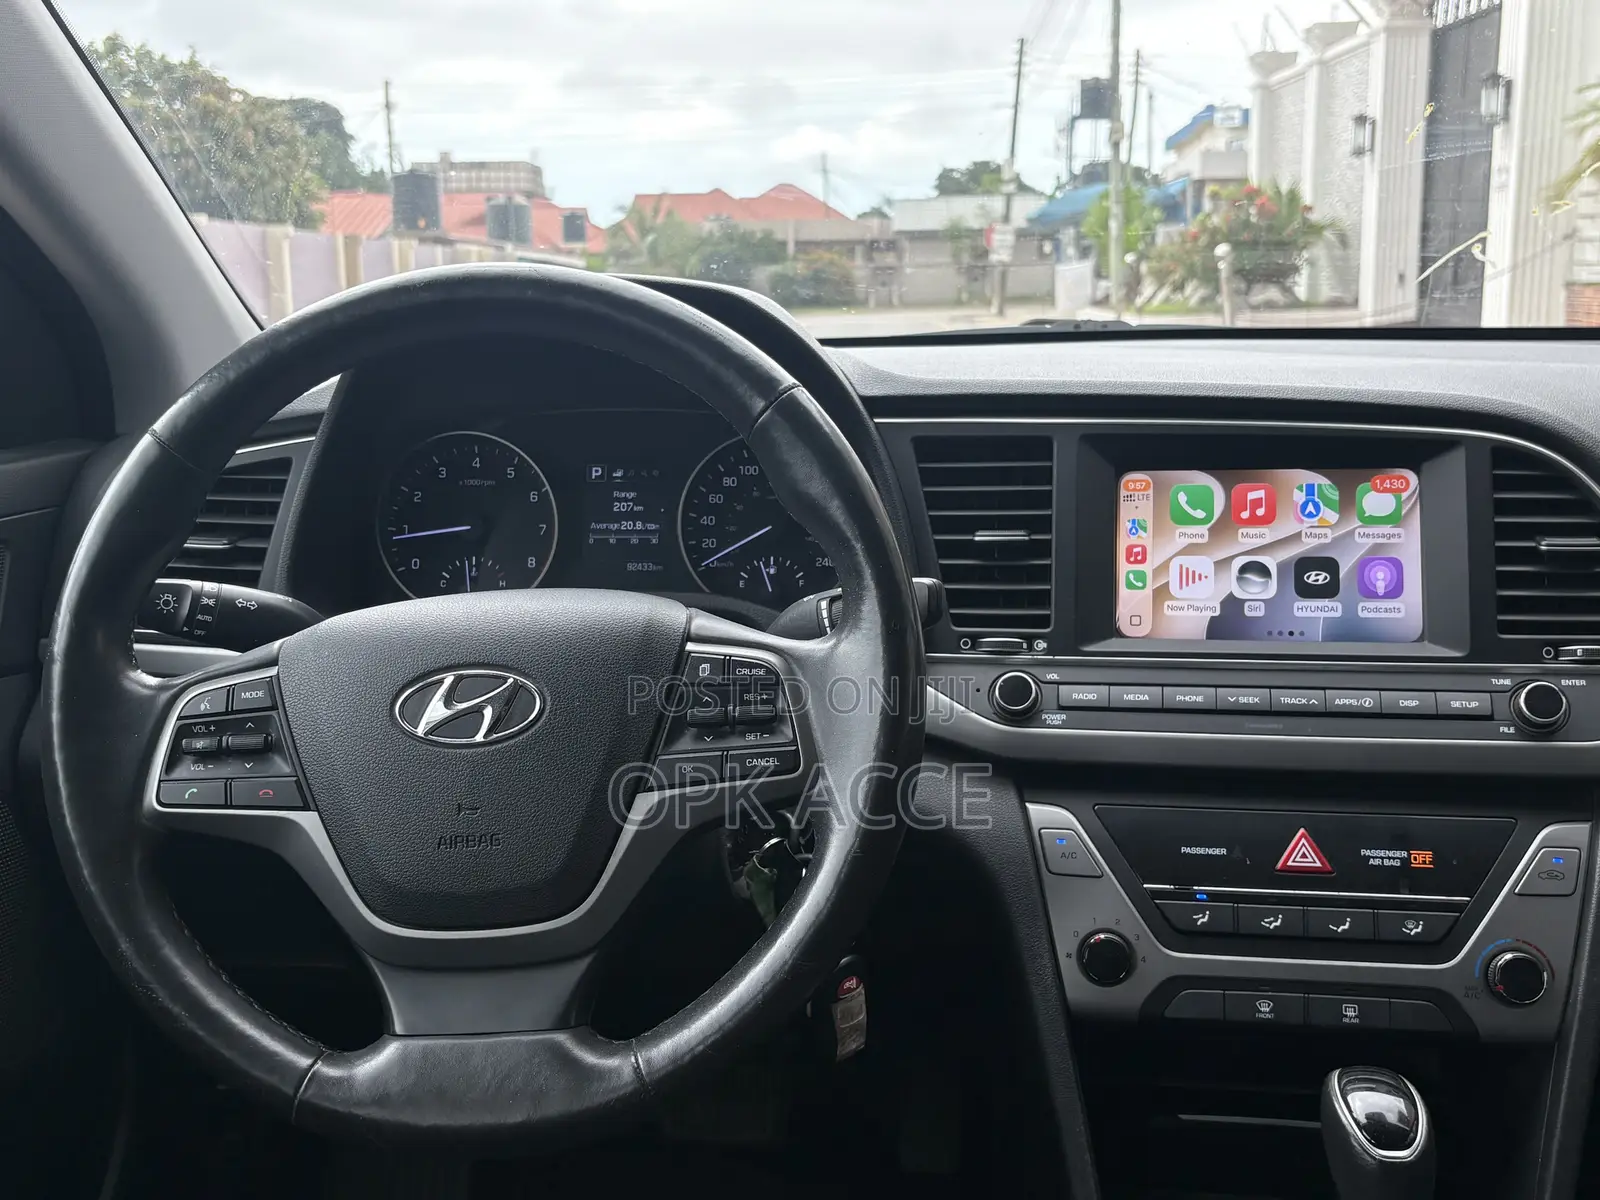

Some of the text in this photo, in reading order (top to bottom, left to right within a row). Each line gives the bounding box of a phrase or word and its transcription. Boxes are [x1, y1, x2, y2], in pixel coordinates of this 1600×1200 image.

[472, 457, 481, 468] 4
[438, 468, 447, 478] 3
[506, 468, 515, 478] 5
[591, 466, 602, 479] P
[739, 465, 759, 475] 100
[723, 477, 737, 487] 80
[1128, 482, 1147, 490] 9:57
[1374, 479, 1406, 490] 1,430
[414, 491, 422, 502] 2
[530, 491, 538, 502] 6
[613, 491, 637, 500] Range
[708, 494, 724, 504] 60
[1137, 493, 1151, 501] LTE
[700, 516, 715, 526] 40
[539, 525, 547, 535] 7
[1178, 531, 1205, 540] Phone
[1241, 531, 1266, 540] Music
[1304, 531, 1329, 541] Maps
[1358, 531, 1402, 541] Messages
[702, 538, 716, 548] 20
[411, 559, 420, 569] 0
[528, 557, 536, 568] 8
[440, 580, 447, 588] C
[500, 580, 506, 588] H
[739, 580, 745, 588] E
[799, 580, 804, 588] F
[1167, 604, 1217, 615] Now Playing
[1247, 604, 1262, 612] Siri
[1297, 605, 1338, 613] HYUNDAI
[1361, 605, 1402, 614] Podcasts
[736, 668, 766, 676] CRUISE
[1491, 678, 1511, 686] TUNE
[241, 690, 265, 699] MODE
[1072, 692, 1097, 700] RADIO
[1123, 693, 1149, 701] MEDIA
[1176, 694, 1204, 702] PHONE
[1280, 697, 1308, 705] TRACK
[1399, 699, 1419, 707] DISP
[1450, 700, 1479, 708] SETUP
[1042, 713, 1066, 721] POWER
[746, 757, 780, 767] CANCEL
[682, 765, 694, 774] OK
[437, 834, 501, 850] AIRBAG
[1060, 851, 1077, 859] A/C
[1181, 846, 1227, 856] PASSENGER
[1361, 849, 1408, 858] PASSENGER
[1368, 858, 1401, 866] AIR BAG
[1410, 854, 1433, 864] OFF
[1115, 918, 1121, 926] 2
[1073, 930, 1079, 938] 0
[1134, 933, 1140, 941] 3
[1140, 955, 1147, 964] 4
